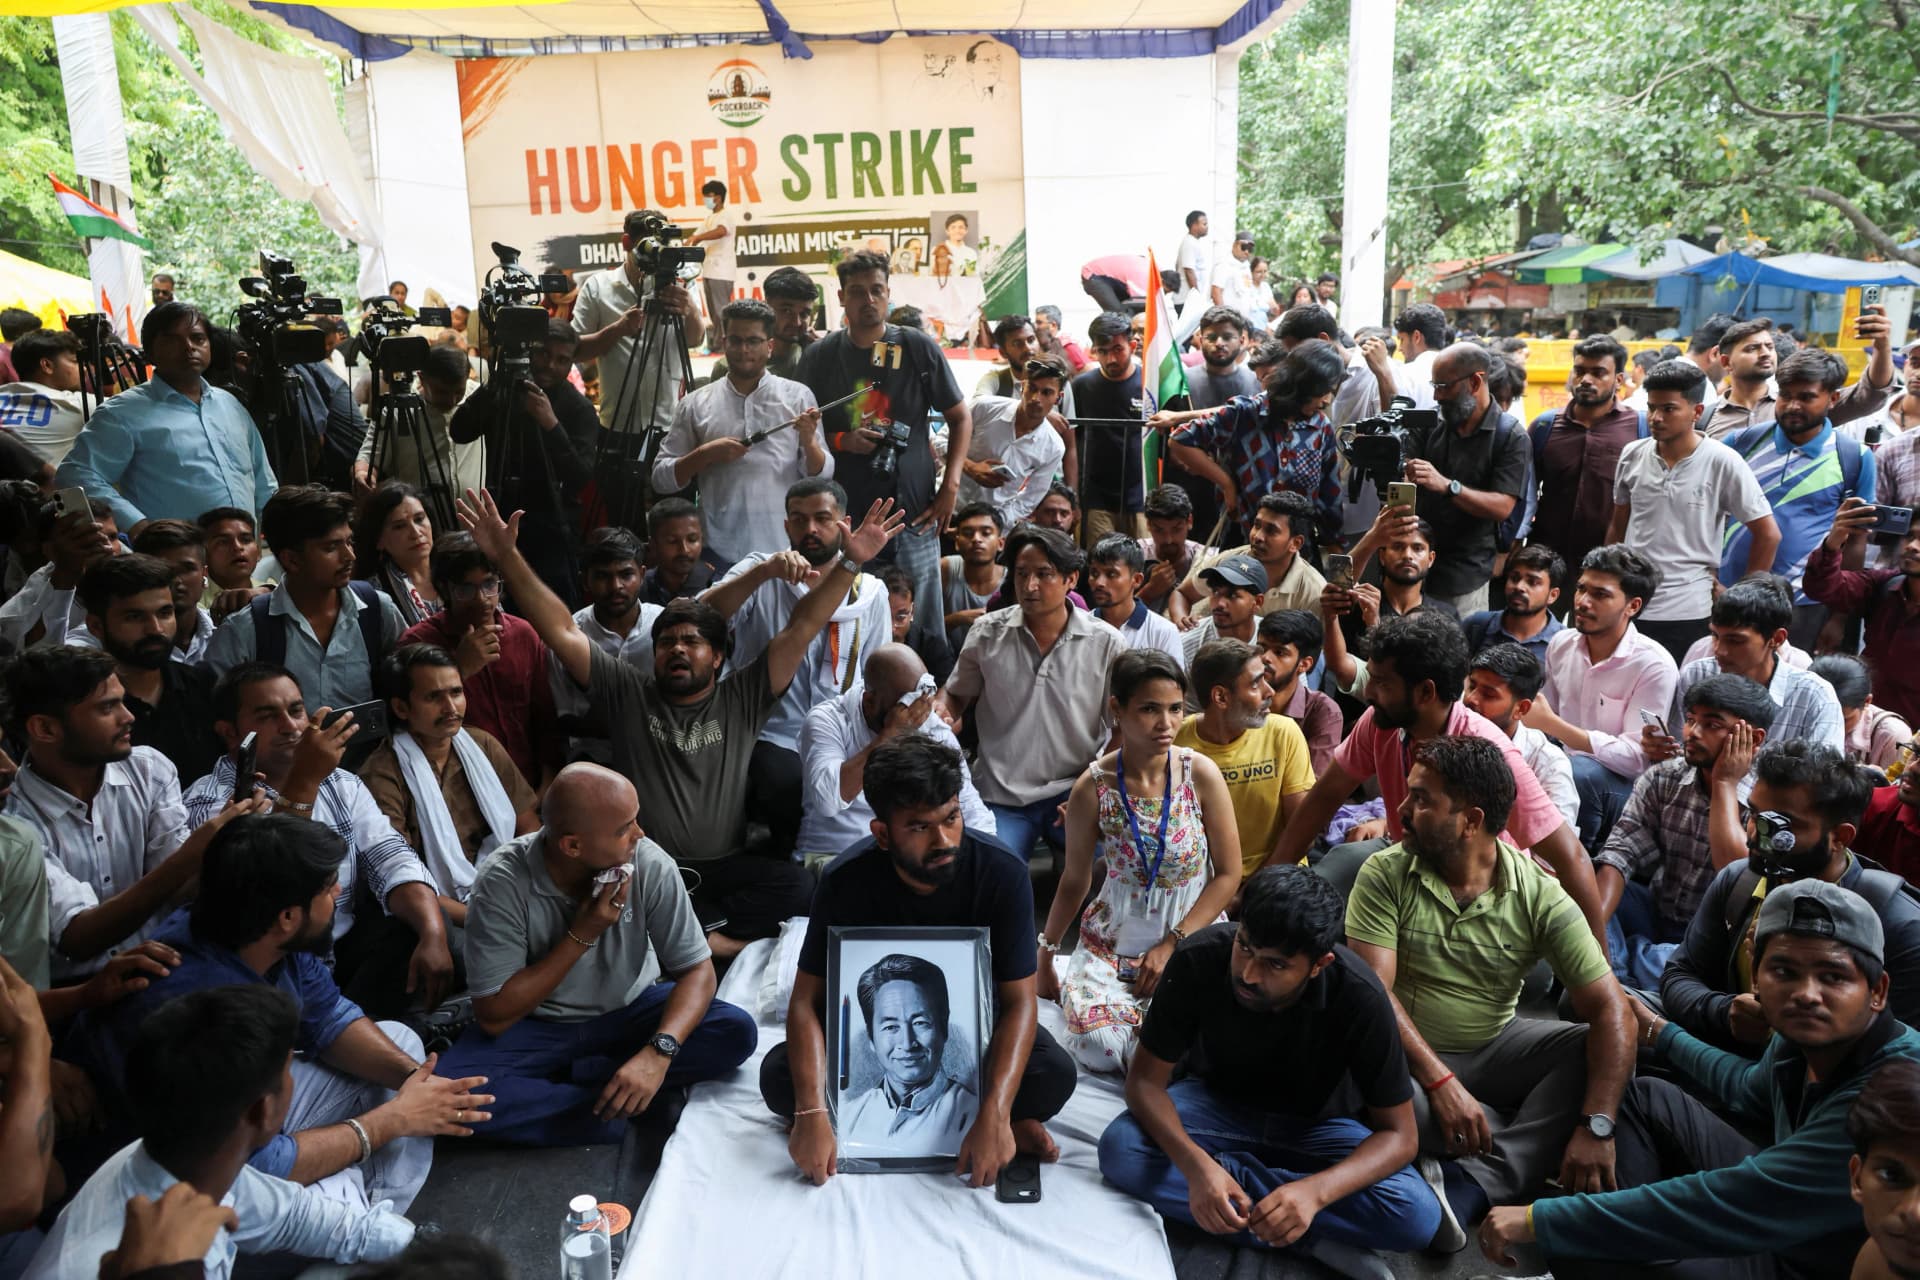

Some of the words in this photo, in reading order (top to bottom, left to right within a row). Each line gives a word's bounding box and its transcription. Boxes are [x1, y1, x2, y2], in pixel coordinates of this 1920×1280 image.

[719, 101, 763, 112] COCKROACH
[525, 137, 762, 215] HUNGER
[780, 127, 977, 202] STRIKE
[736, 231, 800, 256] ADHAN
[676, 731, 722, 751] SURFING
[1244, 765, 1273, 778] UNO
